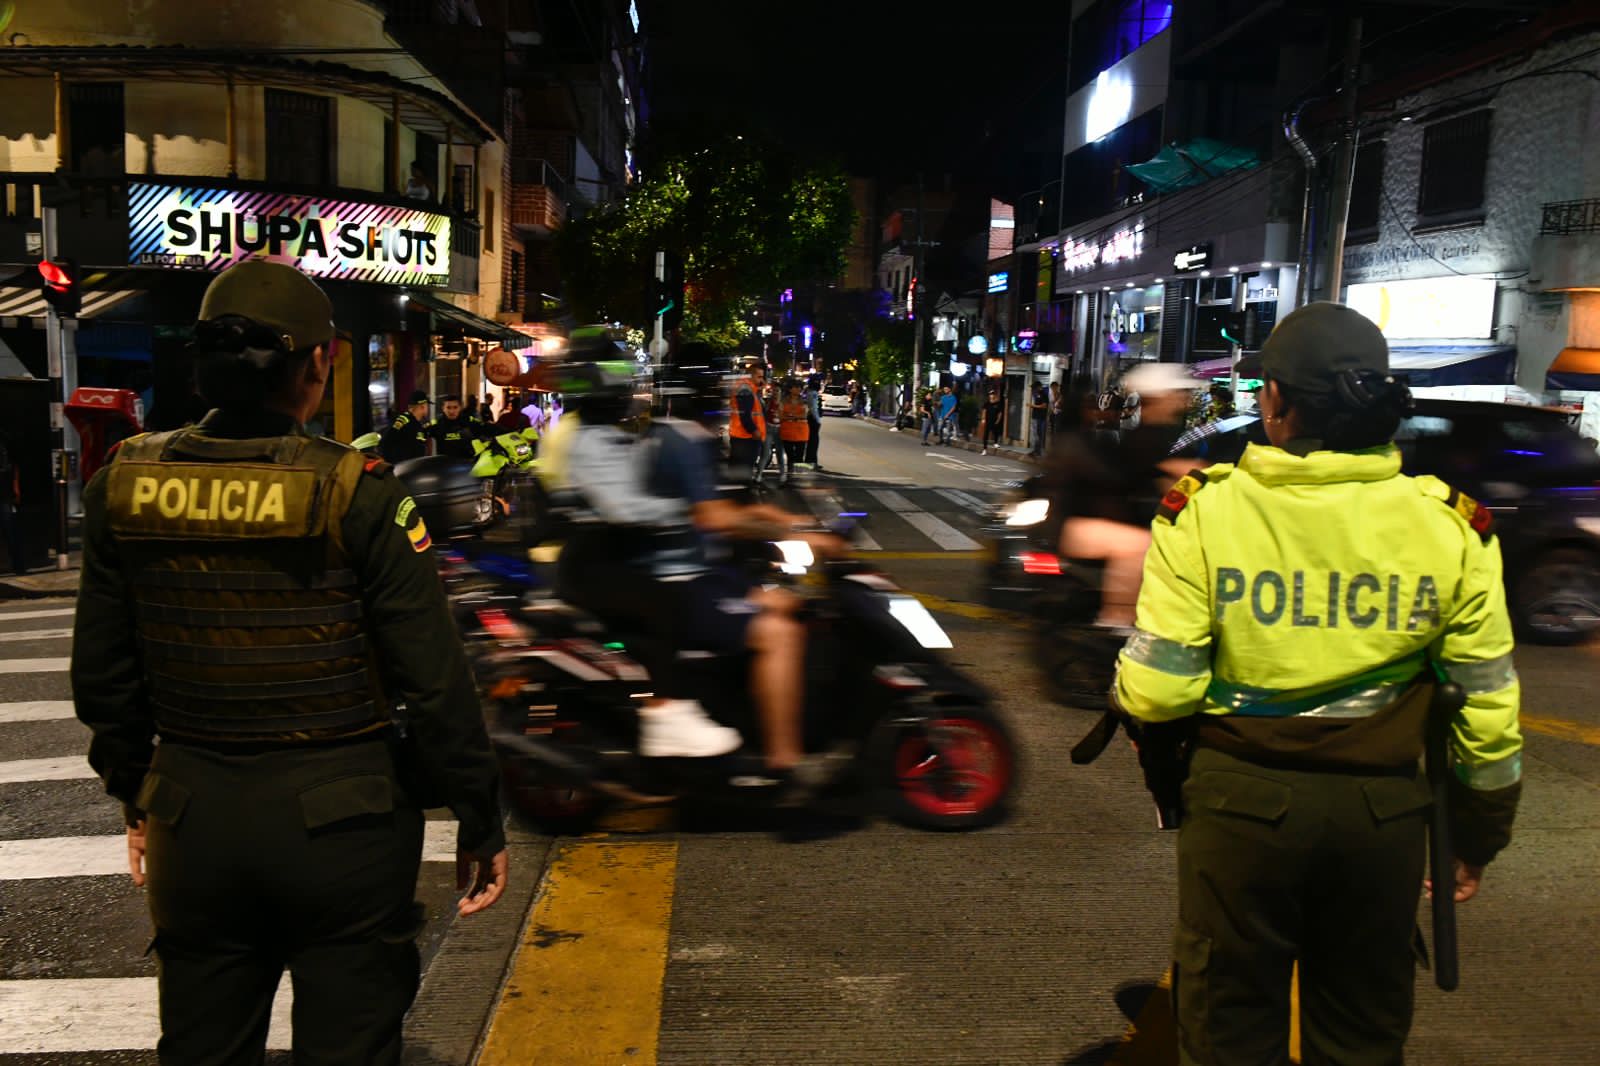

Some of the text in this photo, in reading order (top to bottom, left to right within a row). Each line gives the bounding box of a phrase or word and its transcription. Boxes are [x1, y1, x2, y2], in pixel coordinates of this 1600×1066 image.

[167, 208, 437, 266] SHUPA SHOTS
[130, 477, 286, 522] POLICIA
[1215, 567, 1441, 631] POLICIA
